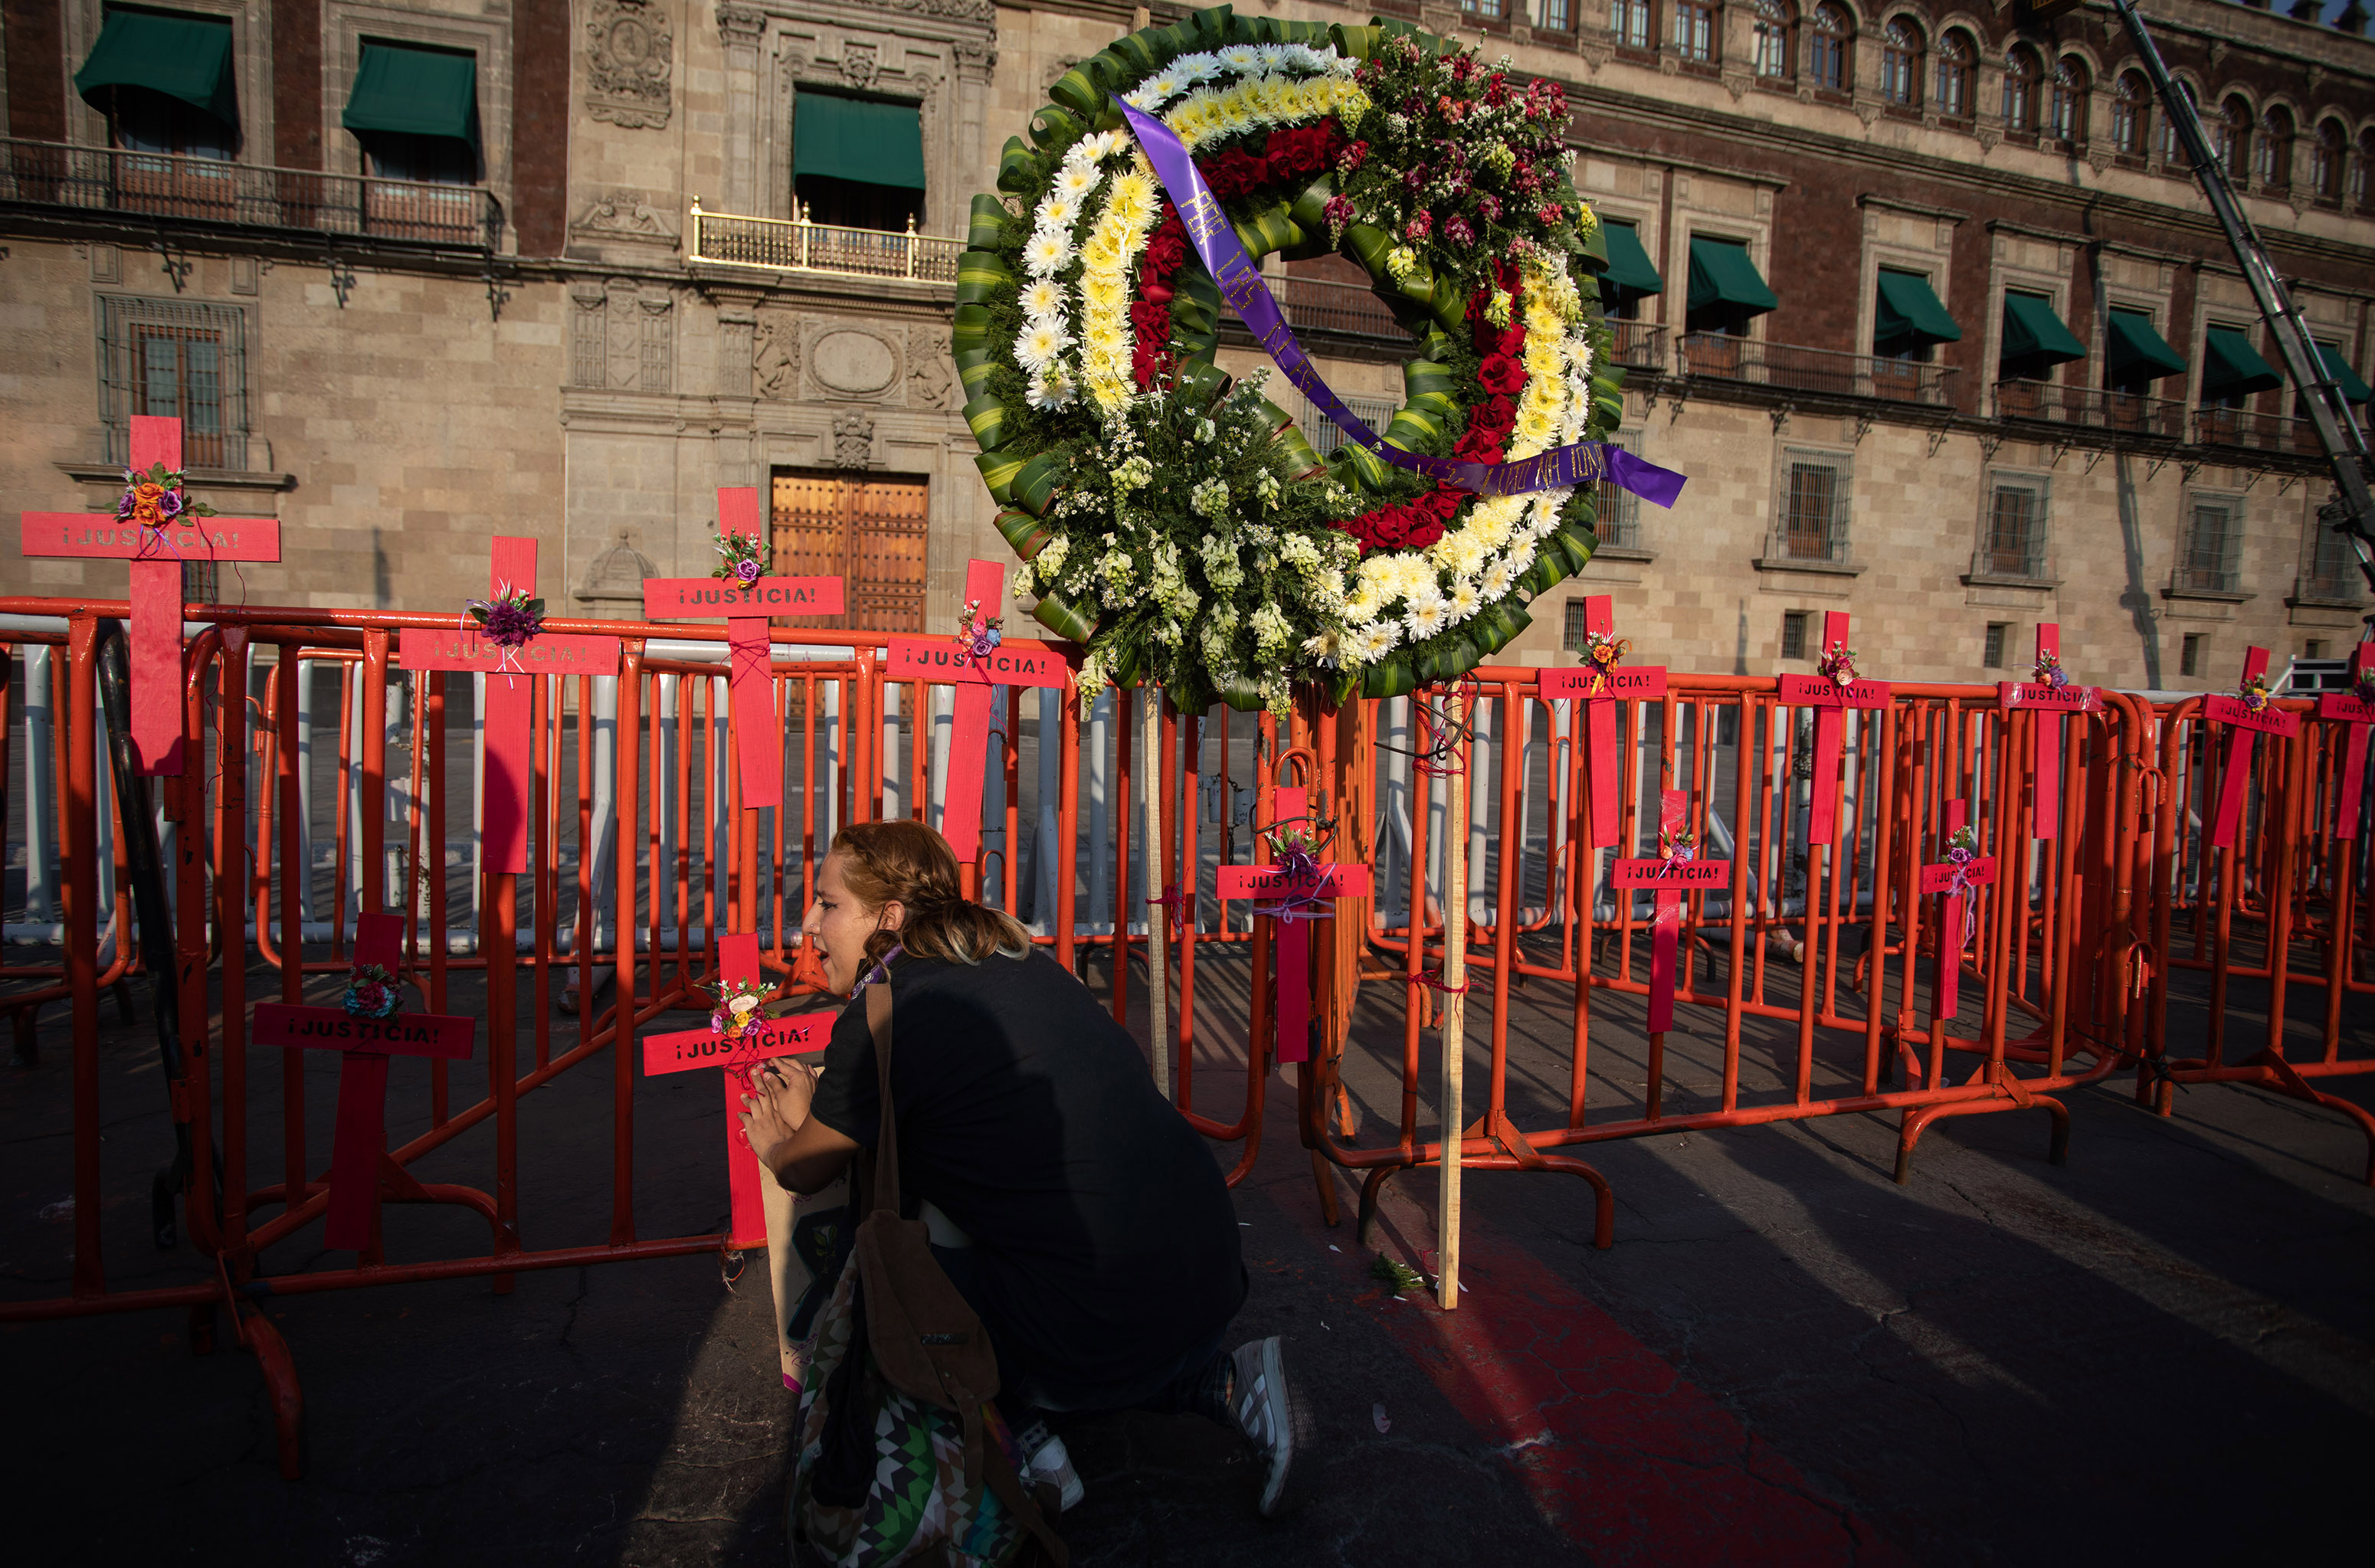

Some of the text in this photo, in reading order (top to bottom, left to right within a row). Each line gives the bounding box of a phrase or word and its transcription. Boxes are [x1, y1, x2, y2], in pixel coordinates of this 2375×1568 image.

[1180, 190, 1226, 245] POR
[1216, 250, 1265, 310] LAS
[1261, 319, 1319, 395] NIAS
[63, 527, 239, 549] ¡JUSTICIA!
[680, 588, 815, 604] ¡JUSTICIA!
[1562, 675, 1649, 688] ¡JUSICIA!
[1799, 683, 1874, 699] ¡JUSICIA!
[2337, 702, 2375, 715] ¡JUSI
[1627, 867, 1718, 879] ¡JUSTICIA!
[1935, 866, 1984, 883] ¡JUSCIA!
[1239, 875, 1343, 889] ¡JUSTICIA!
[288, 1018, 439, 1044] ¡JUSTICIA!
[676, 1030, 809, 1059] ¡JUSTICIA!
